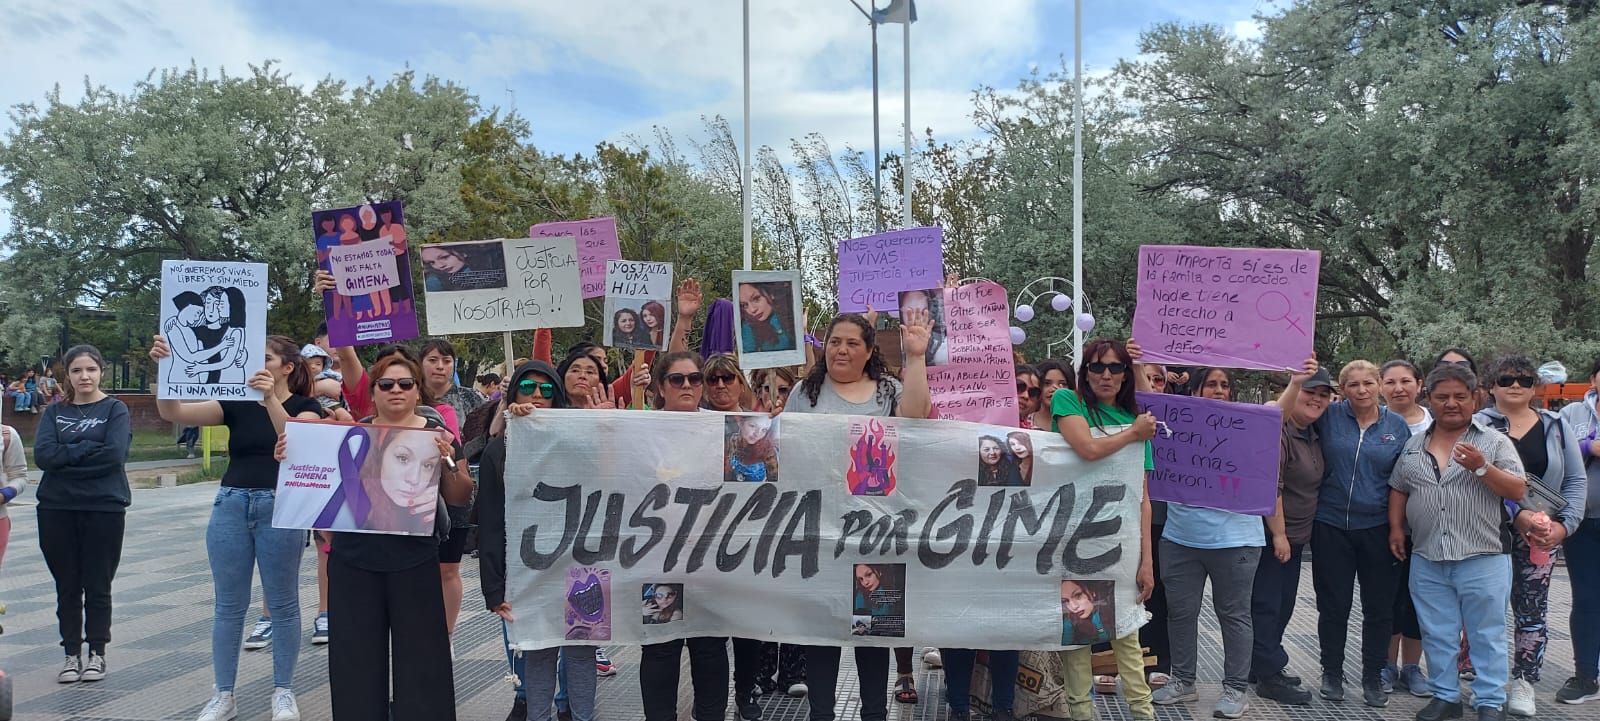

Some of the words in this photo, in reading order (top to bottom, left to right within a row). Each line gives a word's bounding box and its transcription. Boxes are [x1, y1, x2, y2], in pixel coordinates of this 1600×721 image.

[344, 250, 374, 262] ESTAMOS
[376, 248, 396, 257] TODAS
[170, 264, 184, 275] NOS
[184, 266, 226, 275] QUEREMOS
[359, 262, 382, 271] FALTA
[610, 261, 636, 275] NOS
[1147, 252, 1165, 266] NO
[1290, 256, 1308, 274] de
[208, 275, 215, 283] Y
[345, 274, 390, 291] GIMENA
[519, 270, 552, 292] POR
[625, 272, 649, 281] UNA
[1212, 274, 1222, 283] o
[1228, 273, 1289, 285] conocido
[611, 281, 649, 296] HIJA
[951, 288, 971, 303] HOY
[975, 287, 993, 299] FUE
[1152, 288, 1193, 302] Nadie
[453, 297, 541, 323] NOSOTRAS
[1157, 305, 1217, 320] derecho
[1224, 310, 1234, 322] a
[977, 319, 997, 328] SER
[1160, 321, 1227, 339] hacerme
[1164, 340, 1205, 354] daño
[995, 369, 1011, 380] NO
[186, 386, 208, 396] UNA
[210, 386, 247, 397] MENOS
[950, 384, 955, 393] A
[959, 382, 987, 392] SALVO
[947, 400, 962, 408] ES
[966, 397, 977, 407] LA
[978, 396, 1014, 408] TRISTE
[1164, 404, 1193, 423] las
[288, 464, 320, 472] Justicia
[294, 472, 328, 480] GIMENA
[519, 480, 822, 579] JUSTICIA
[917, 478, 1127, 576] GIME
